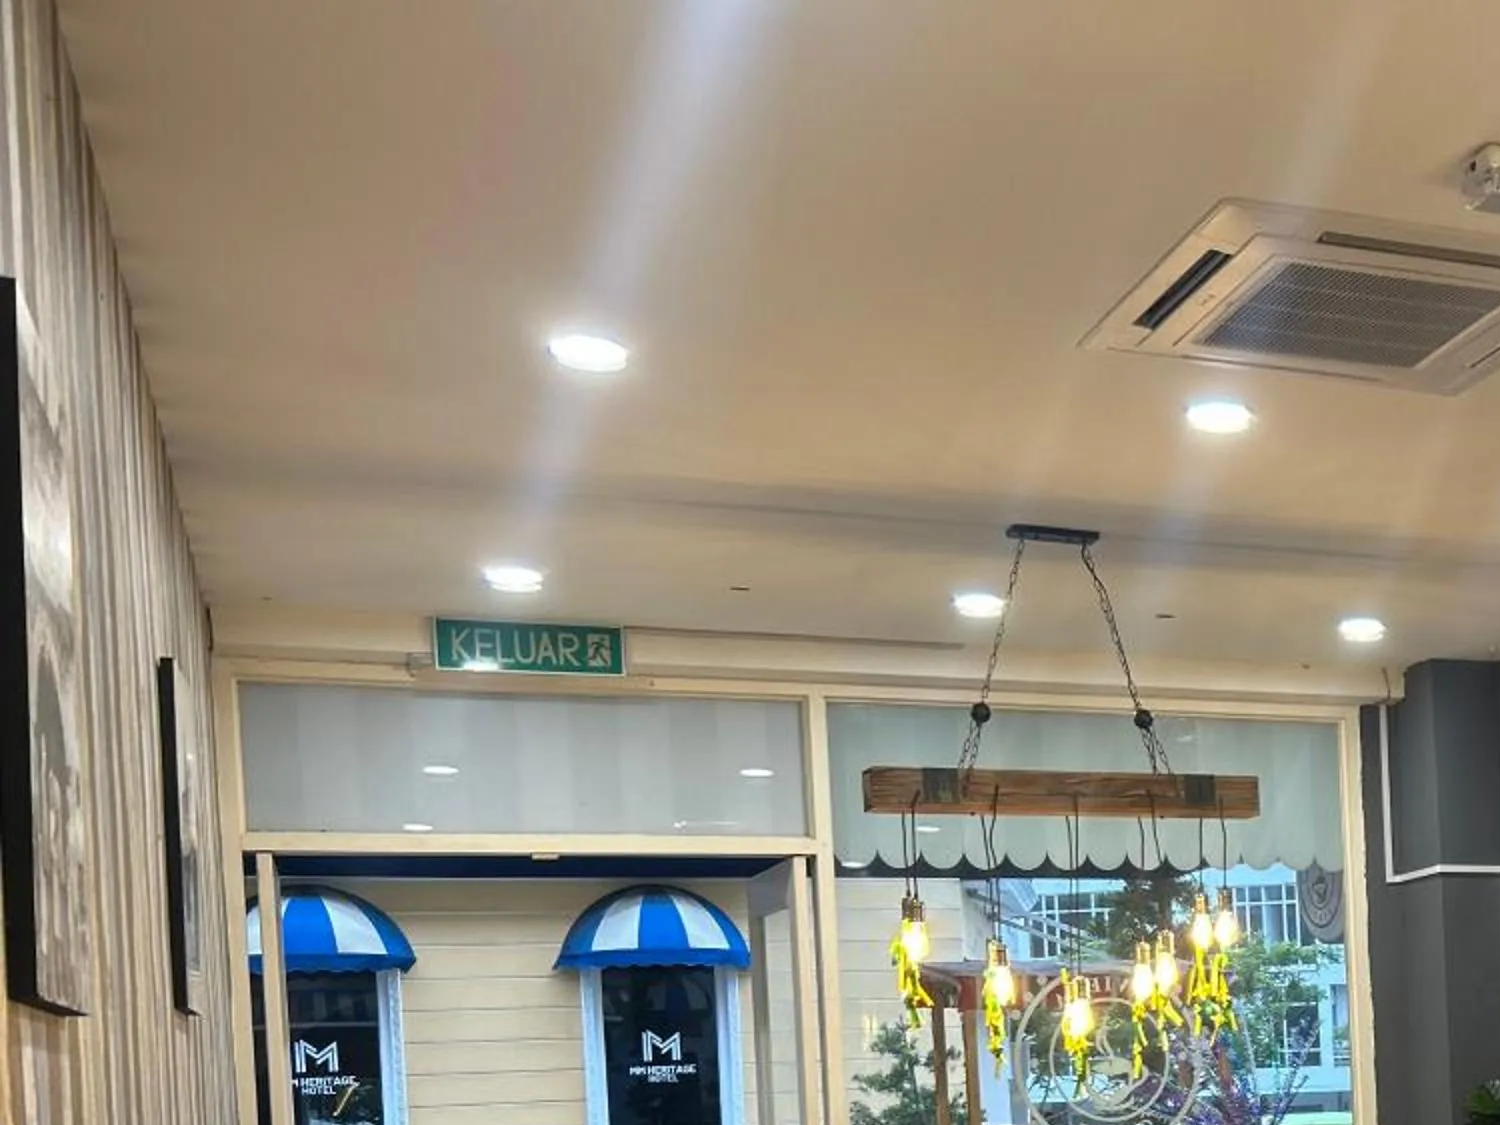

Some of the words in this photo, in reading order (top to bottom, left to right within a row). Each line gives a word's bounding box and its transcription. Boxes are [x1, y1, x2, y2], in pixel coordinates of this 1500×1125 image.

[450, 626, 582, 667] KELUAR
[647, 1063, 697, 1075] HERITAGE
[647, 1073, 679, 1083] HOTEL
[301, 1085, 337, 1096] HOTEL
